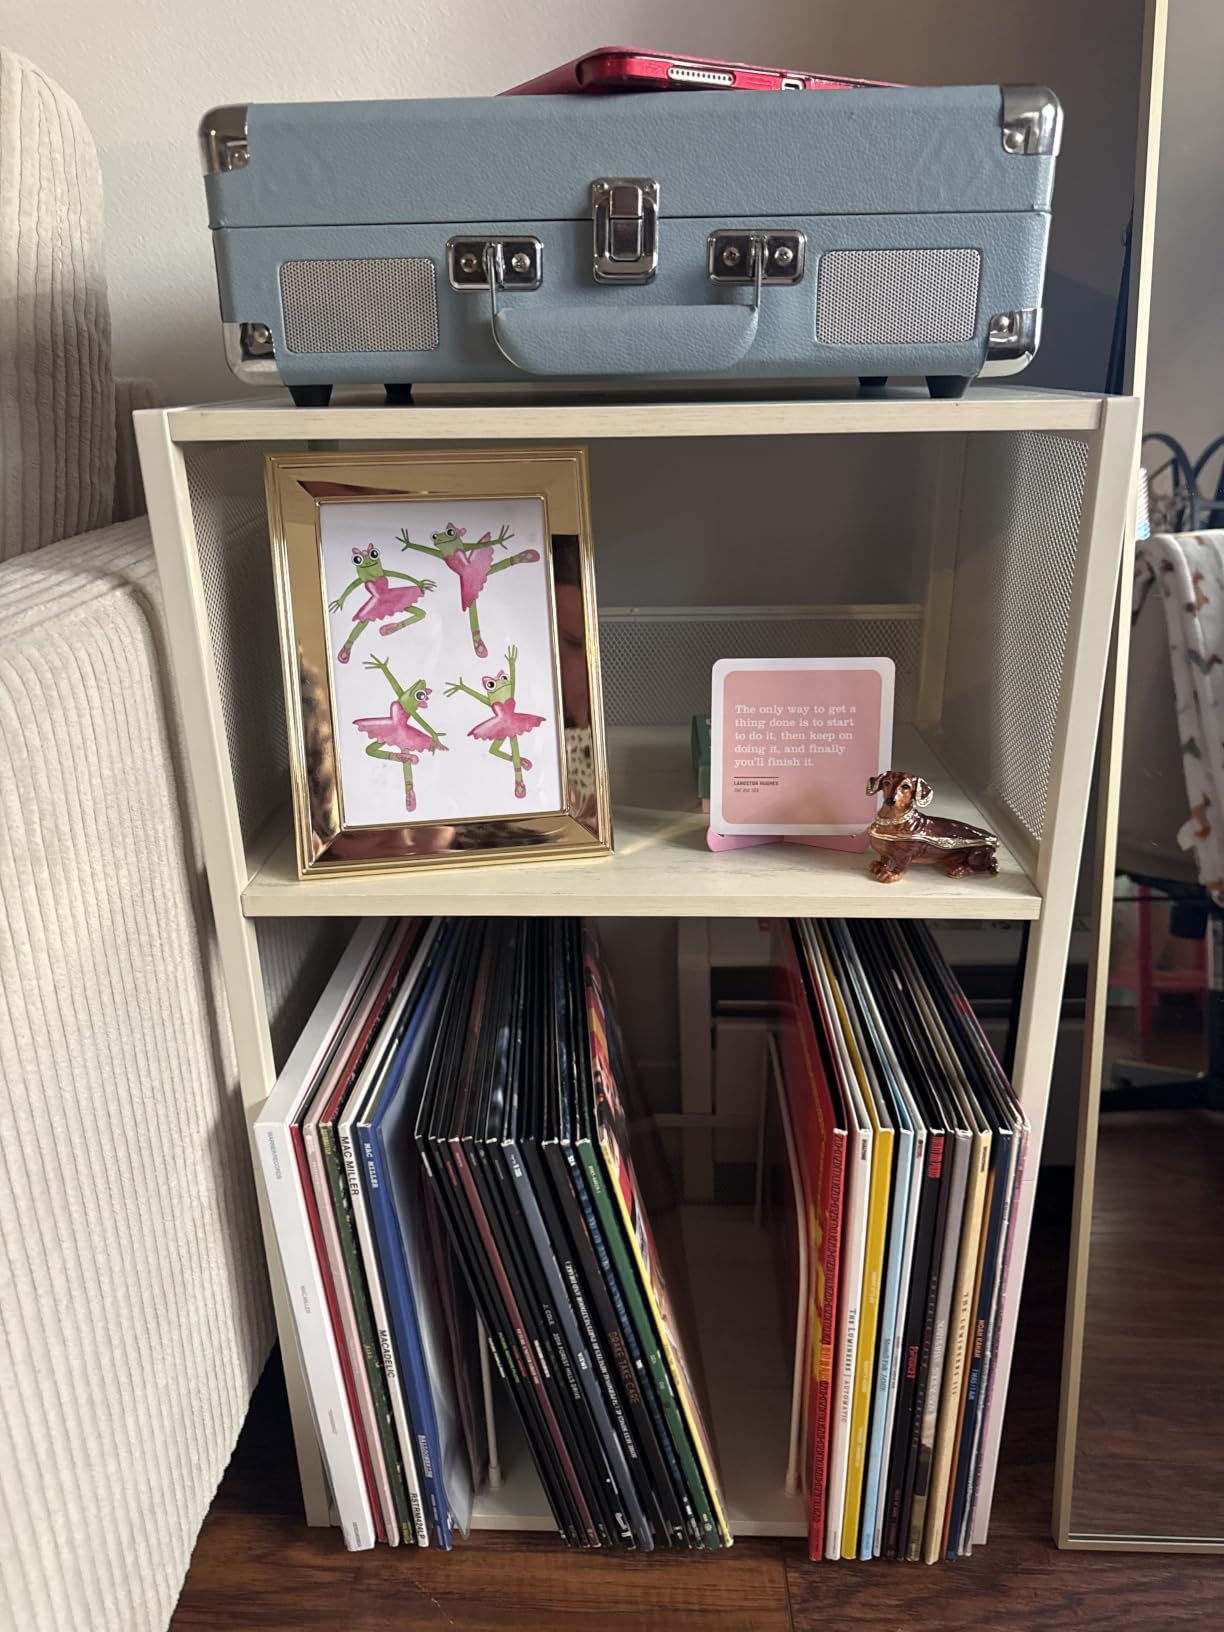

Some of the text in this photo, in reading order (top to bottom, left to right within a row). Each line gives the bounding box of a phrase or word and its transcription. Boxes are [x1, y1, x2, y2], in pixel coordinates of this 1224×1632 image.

[735, 705, 756, 714] The
[759, 705, 784, 716] only
[787, 706, 810, 716] way
[814, 705, 825, 714] to
[828, 705, 847, 716] get
[735, 718, 855, 729] thing done is to start
[735, 730, 853, 742] to do it, then keep on
[734, 744, 846, 756] doing it, and finally
[734, 757, 815, 769] you'll finish it.
[340, 1137, 360, 1195] MAC MILLER
[364, 1143, 379, 1188] MAC MILLER
[607, 1333, 625, 1356] DRAKE
[954, 1318, 966, 1376] LUMINEERS
[974, 1319, 985, 1358] NOAH KAHAN
[379, 1330, 395, 1378] MACADELIC
[617, 1362, 632, 1377] TAKE
[624, 1384, 641, 1402] CARE
[841, 1380, 850, 1423] AUTOMATIC
